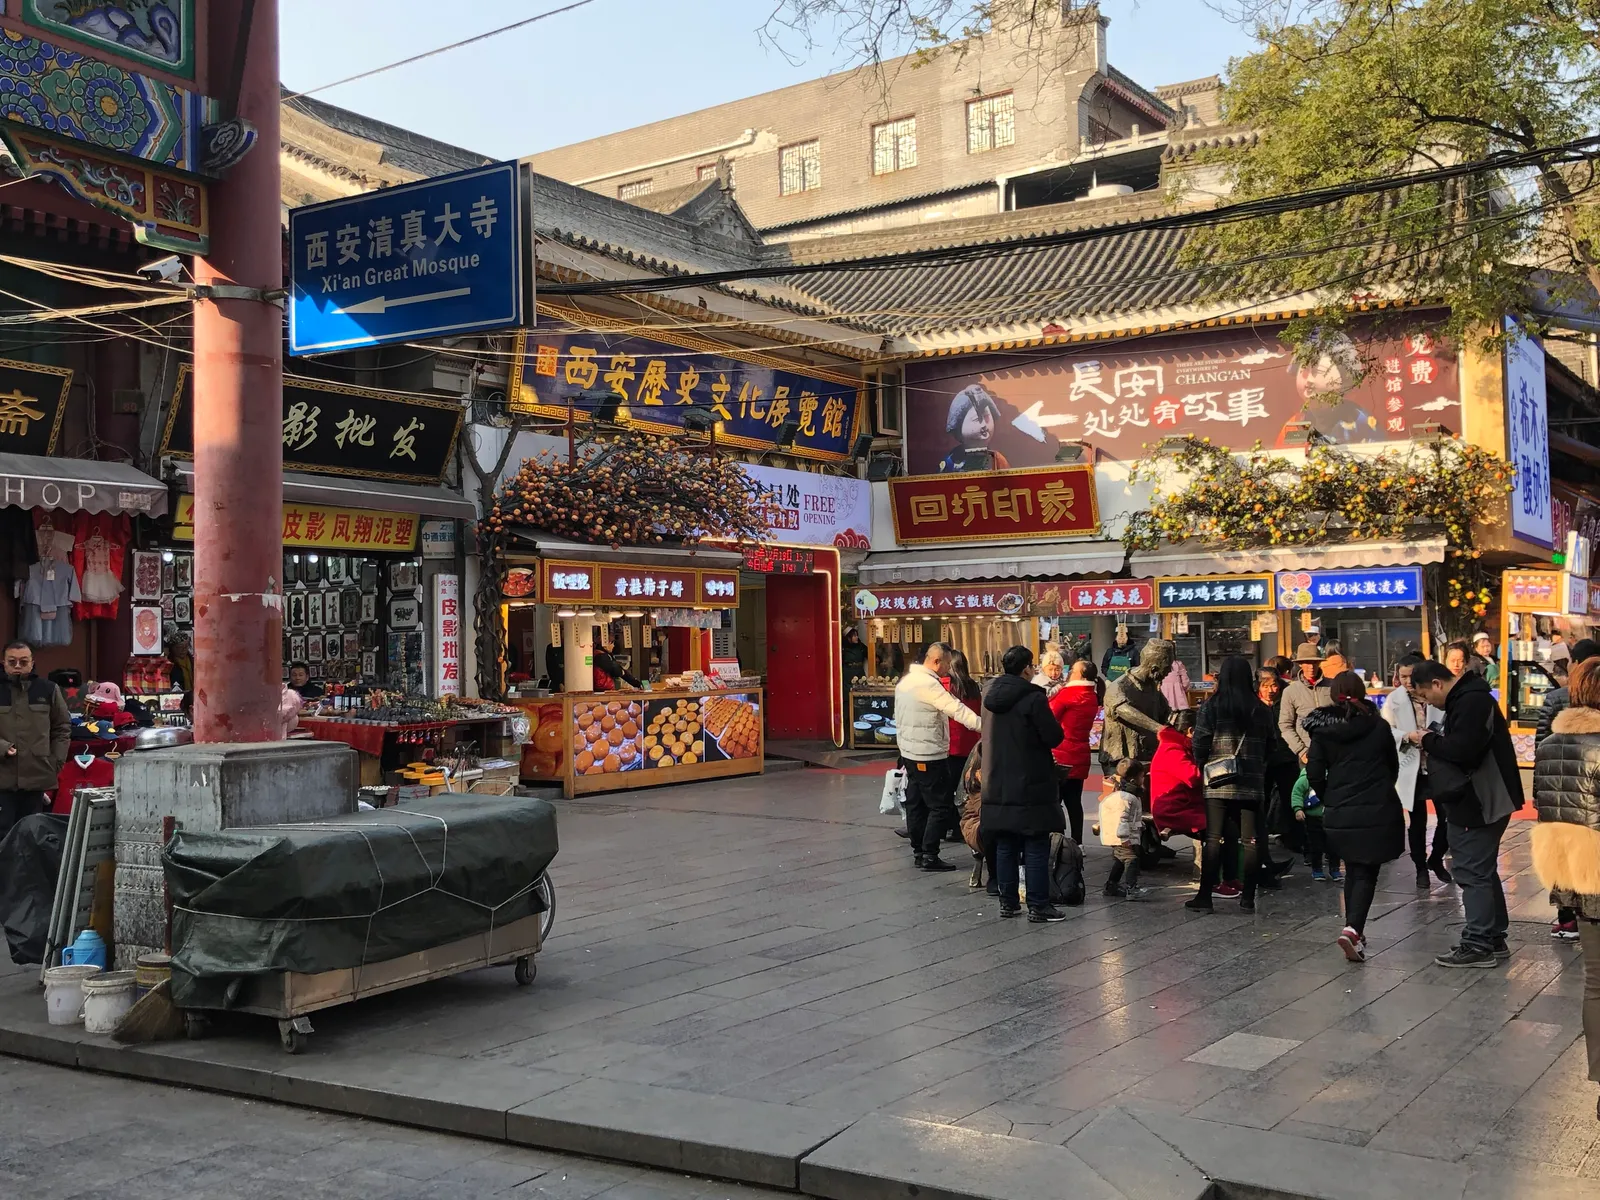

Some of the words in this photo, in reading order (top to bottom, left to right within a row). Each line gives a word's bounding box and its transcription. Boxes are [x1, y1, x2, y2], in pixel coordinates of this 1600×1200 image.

[305, 195, 498, 270] 西安清真大寺
[321, 274, 361, 293] Xi'an
[365, 266, 409, 285] Great
[413, 253, 480, 277] Mosque
[1175, 368, 1251, 385] CHANG'AN
[564, 345, 847, 438] 西安歷史文化展覽館
[1385, 358, 1405, 432] 进馆参观
[282, 401, 425, 461] 影批发
[804, 494, 836, 513] FREE
[283, 508, 326, 541] 皮影
[331, 513, 414, 546] 凤翔泥塑
[803, 513, 836, 526] OPENING
[615, 577, 684, 598] 黄桂柿子饼
[1078, 588, 1144, 606] 油茶麻花
[1163, 584, 1264, 603] 牛奶鸡蛋醪糟
[1318, 579, 1408, 597] 酸奶冰激凌卷
[880, 596, 934, 610] 玫瑰镜糕
[939, 594, 996, 608] 八宝甑糕
[442, 598, 458, 680] 皮影批发
